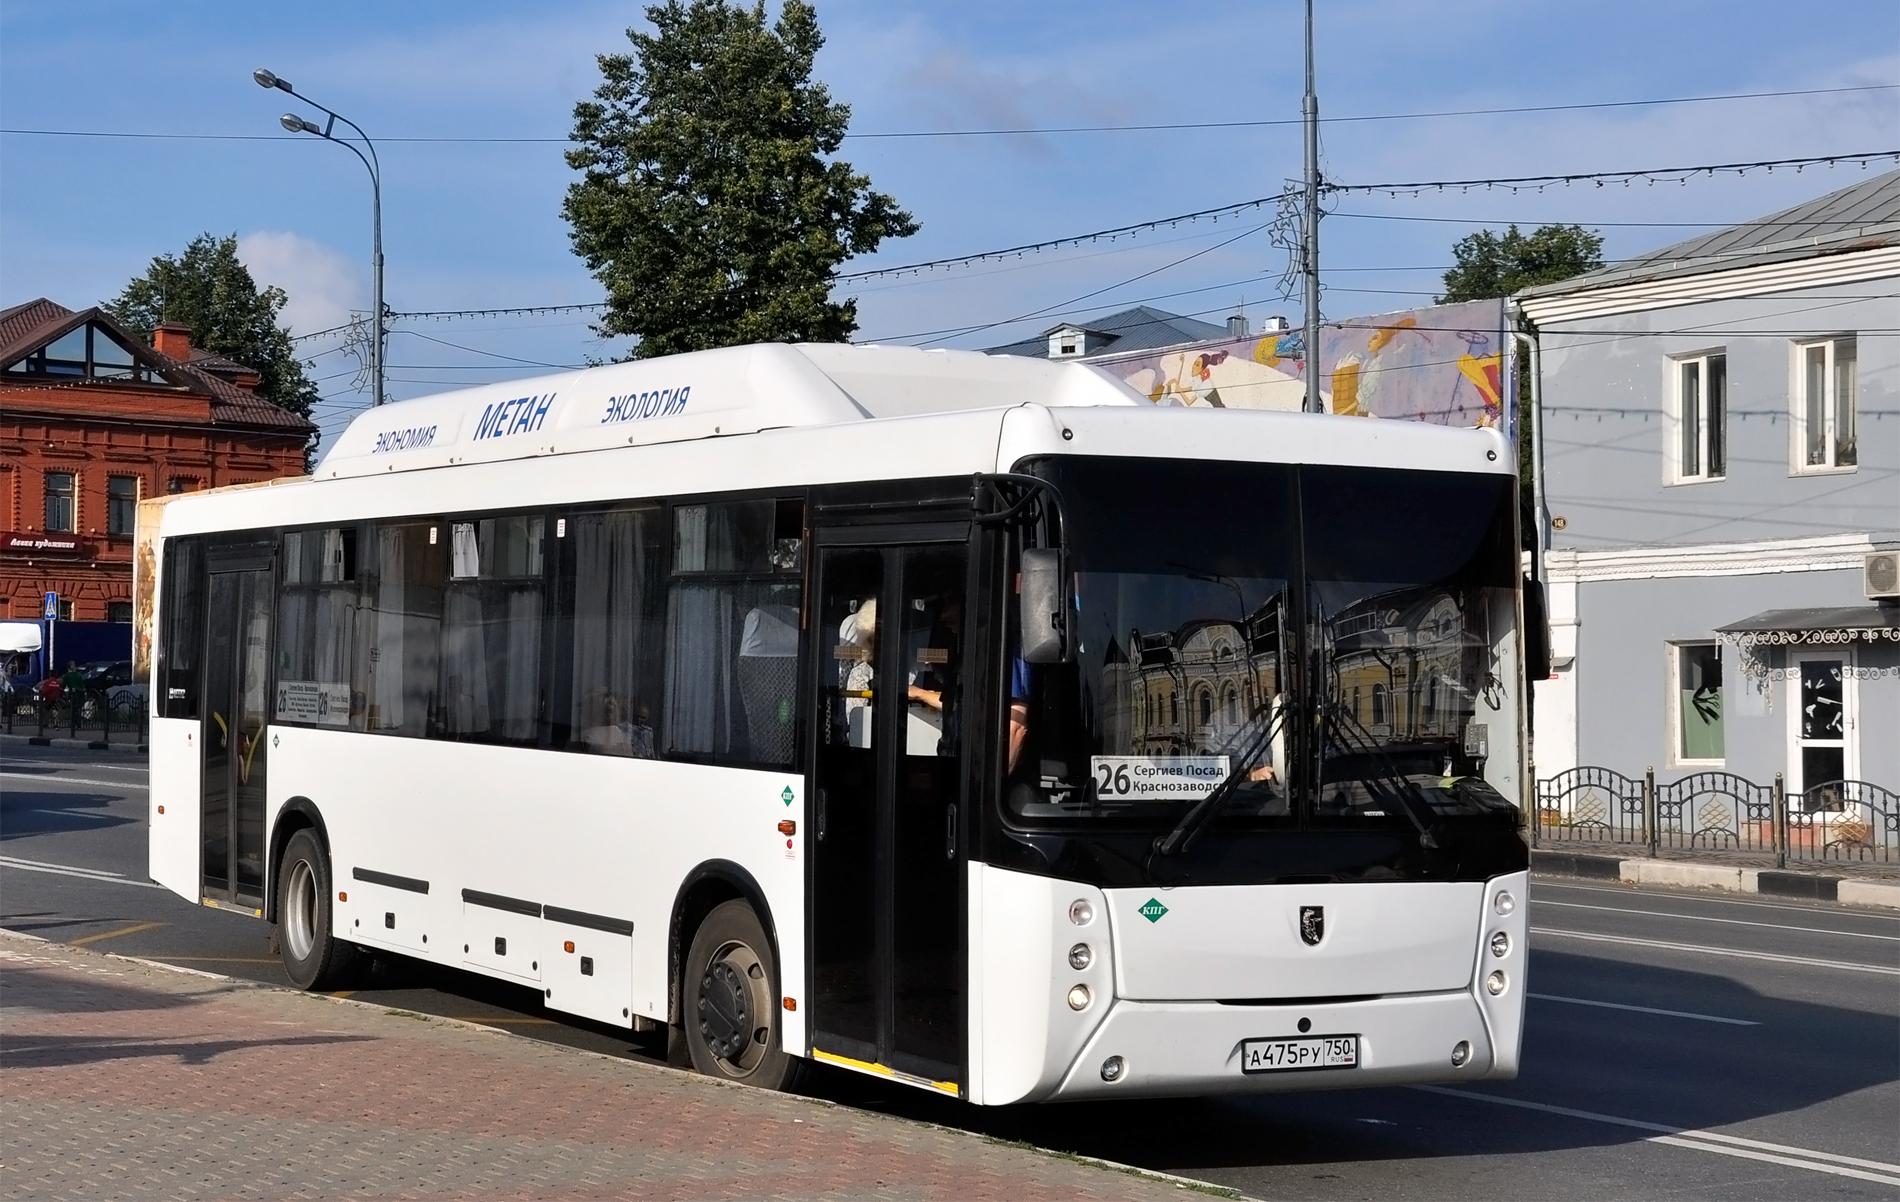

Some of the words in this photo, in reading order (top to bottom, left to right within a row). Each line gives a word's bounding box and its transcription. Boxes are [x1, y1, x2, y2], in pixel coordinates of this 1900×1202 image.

[473, 392, 557, 441] МЕТАН
[600, 386, 690, 424] ЭКОЛОГИЯ
[372, 424, 437, 454] ЭКОНОМИЯ
[279, 688, 287, 713] 26
[319, 691, 328, 716] 26
[1098, 763, 1131, 795] 26
[1134, 765, 1183, 778] Сергиев
[1186, 765, 1224, 777] Посад
[1133, 781, 1225, 794] Краснозаводс
[1143, 906, 1165, 914] КПГ
[1325, 1040, 1350, 1056] 750
